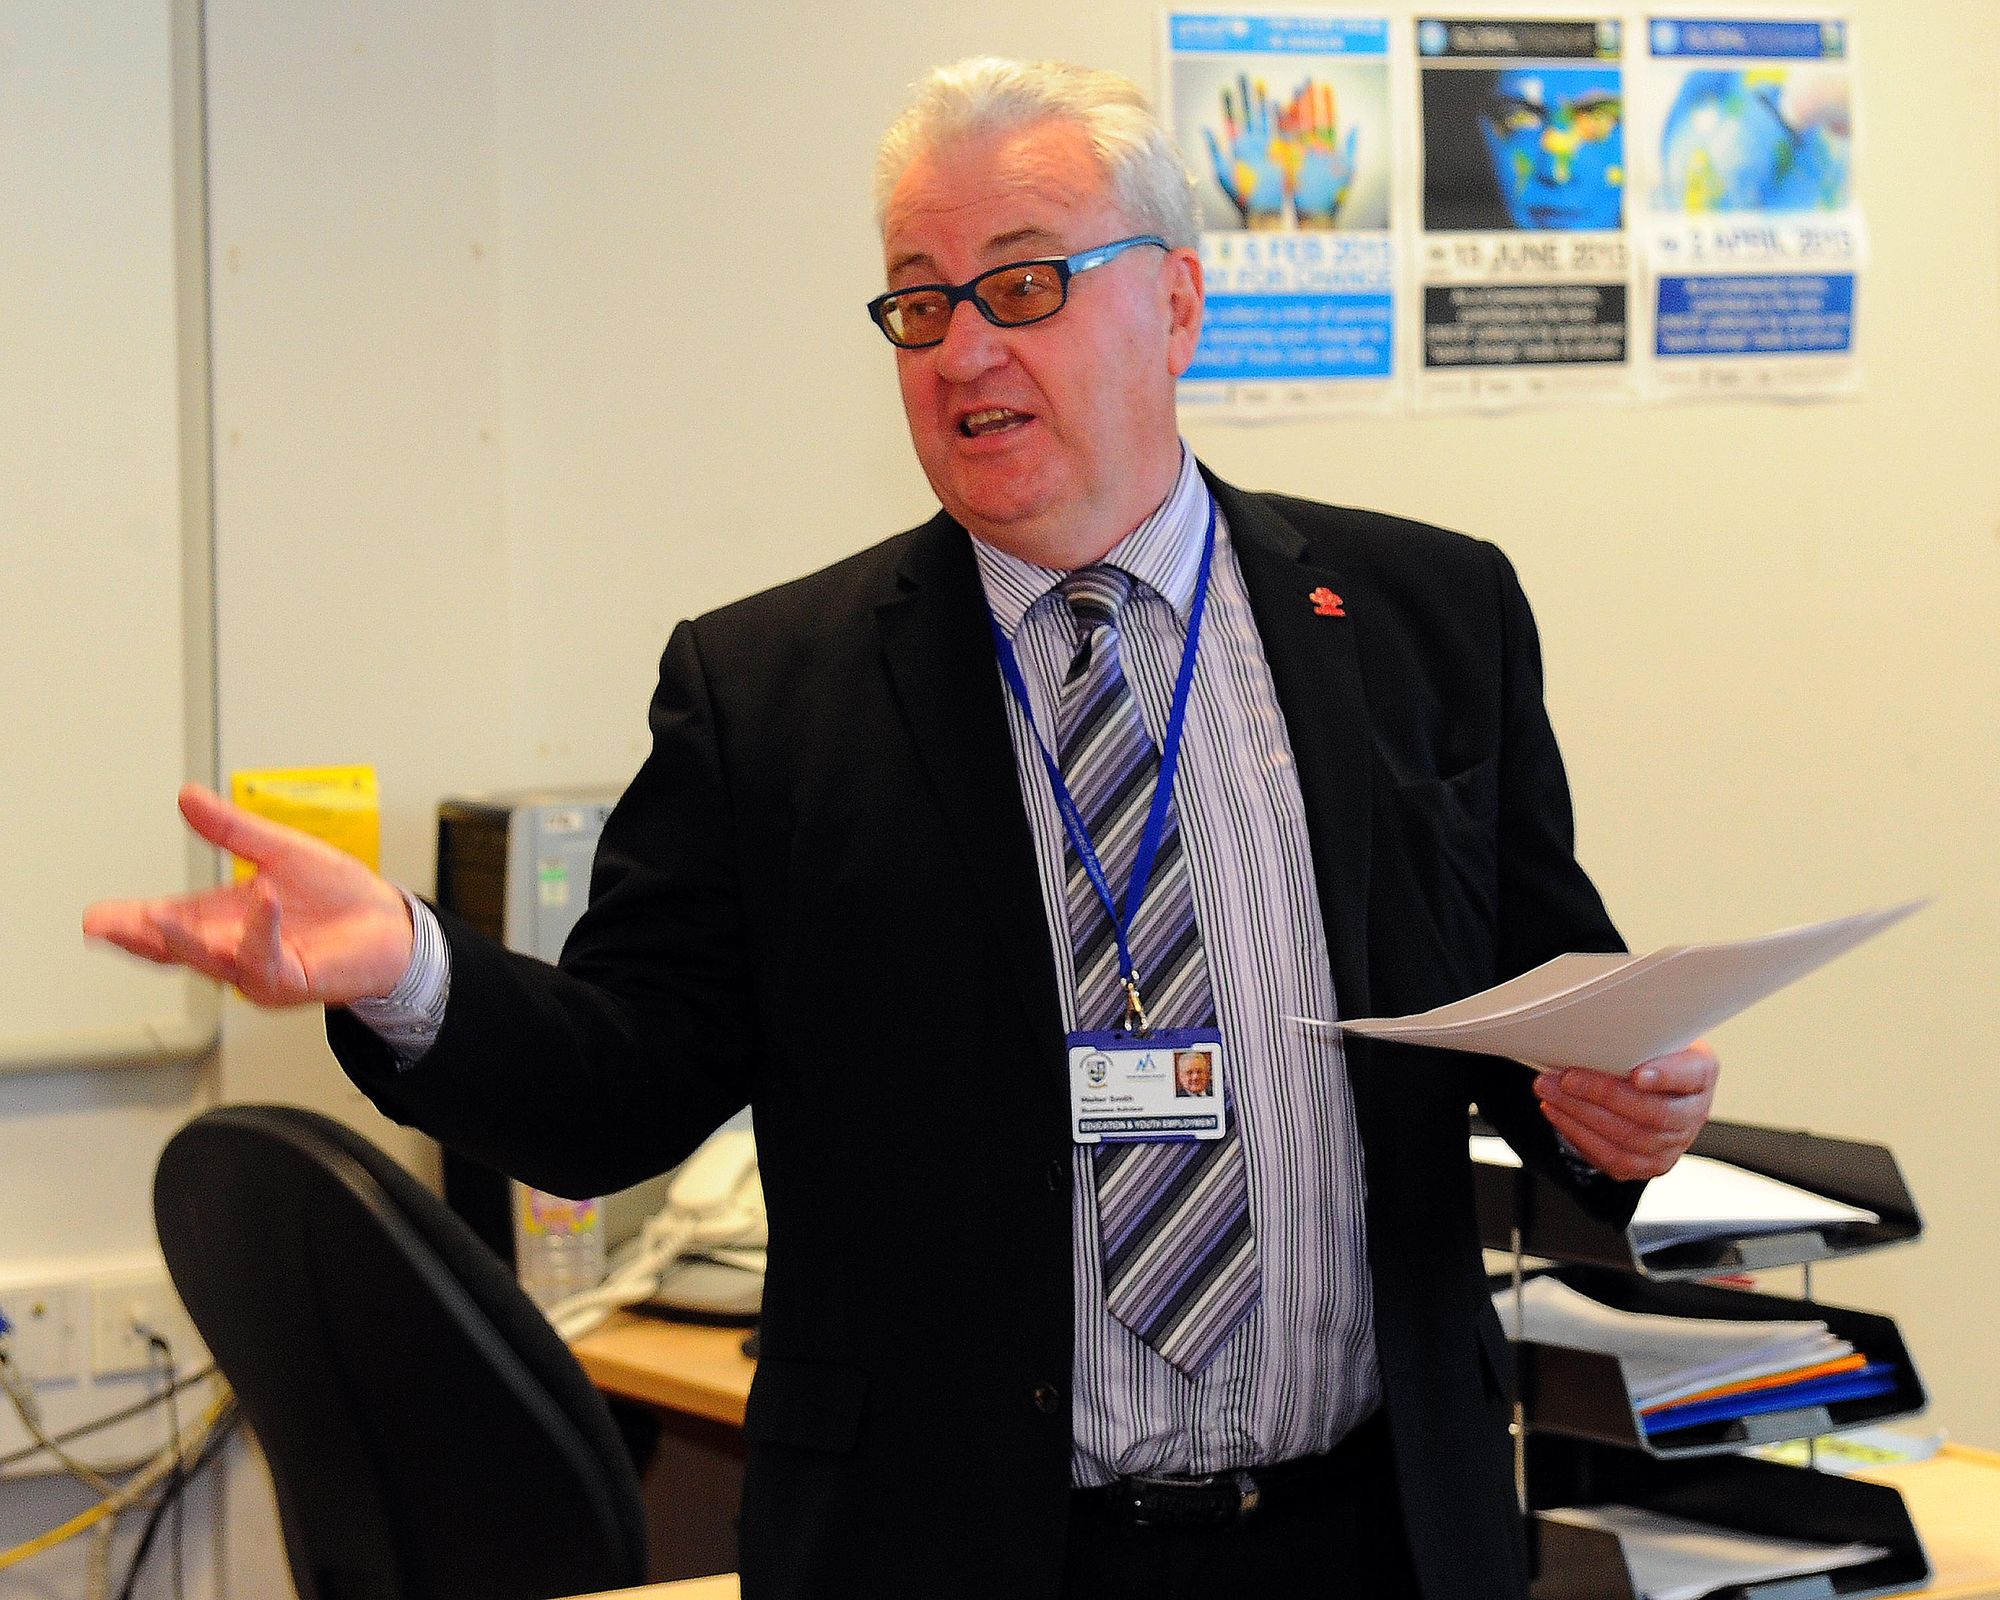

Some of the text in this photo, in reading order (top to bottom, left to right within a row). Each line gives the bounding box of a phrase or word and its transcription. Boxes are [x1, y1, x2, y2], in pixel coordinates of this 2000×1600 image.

[1080, 1117, 1216, 1131] EDUCATION & YOUTH EMPLOYMENT
